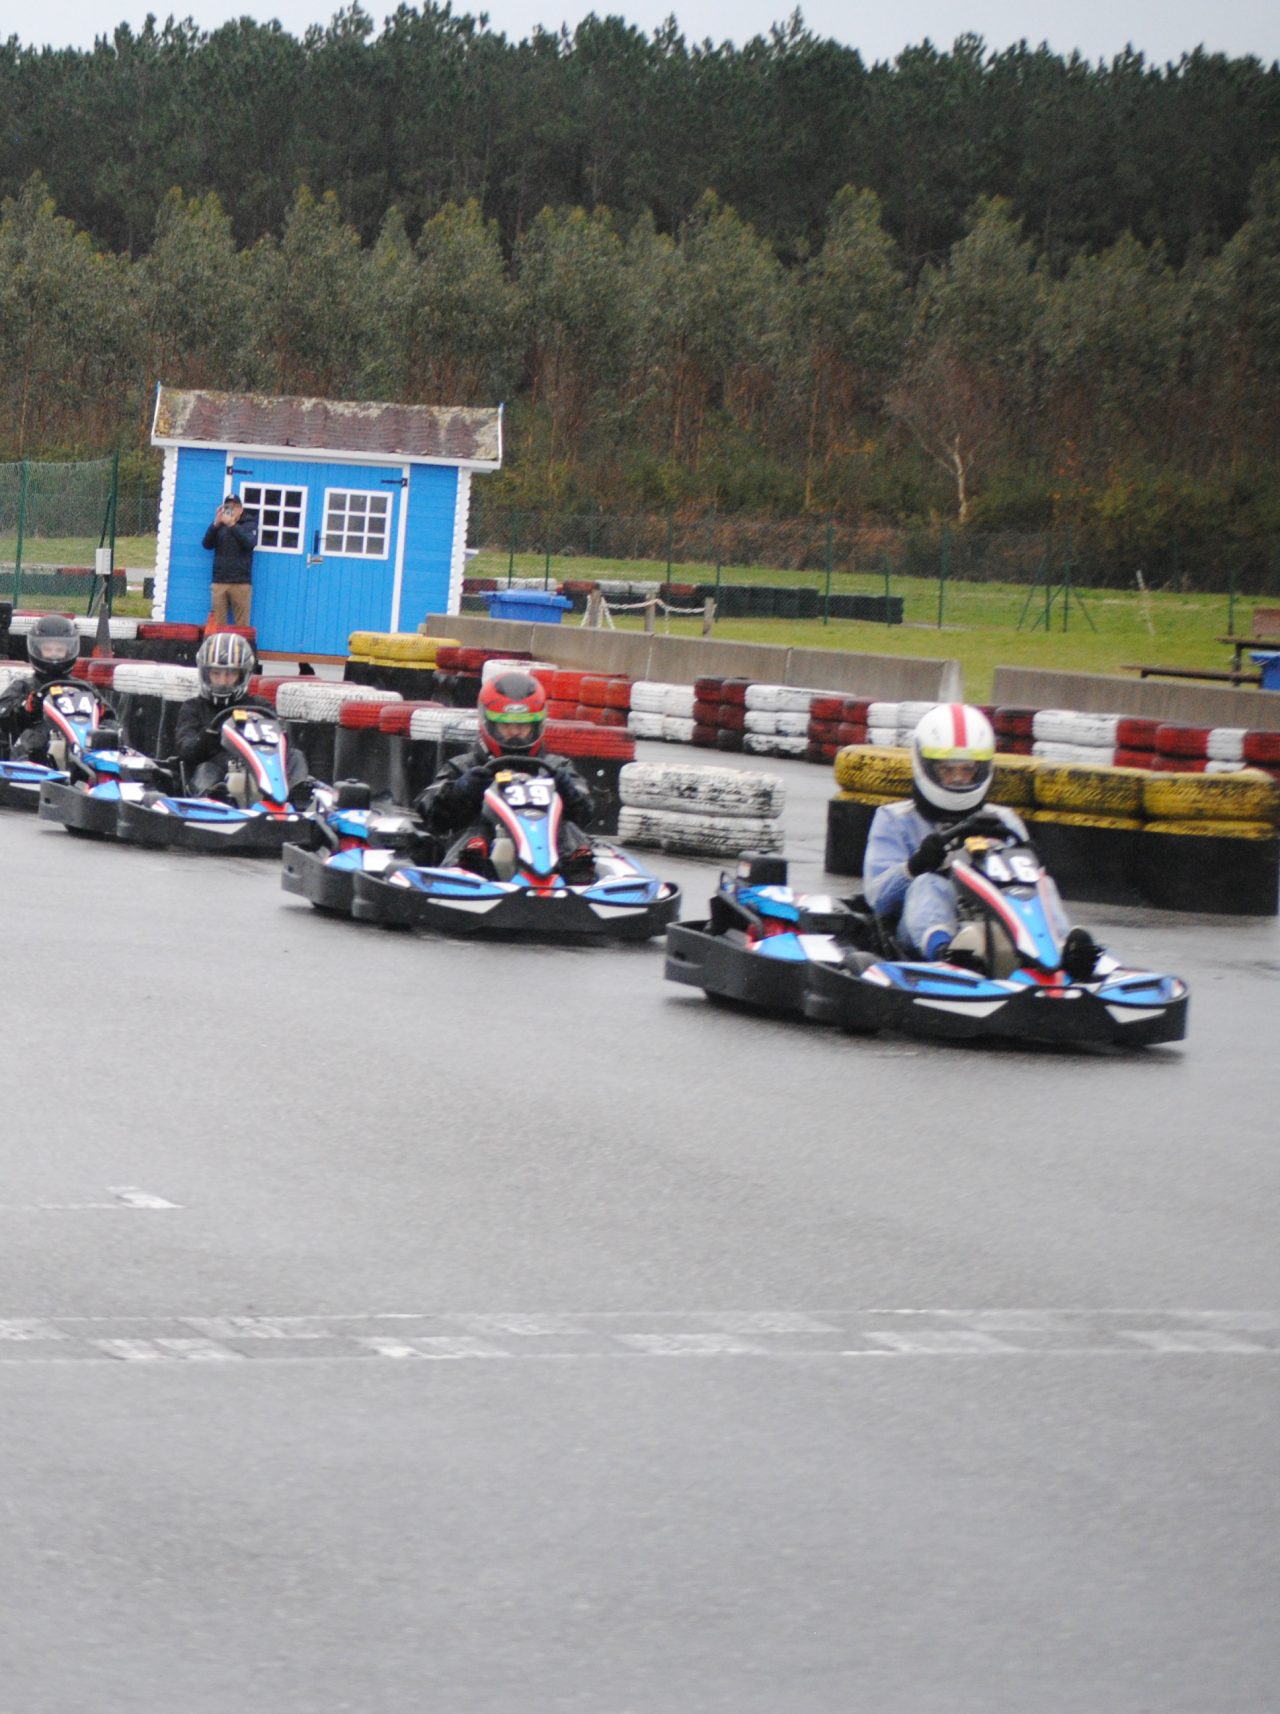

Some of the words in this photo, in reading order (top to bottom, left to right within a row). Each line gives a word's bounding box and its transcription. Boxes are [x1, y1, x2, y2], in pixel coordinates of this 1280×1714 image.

[57, 696, 92, 714] 34
[243, 722, 279, 743] 45
[505, 785, 550, 806] 39
[987, 855, 1039, 882] 46
